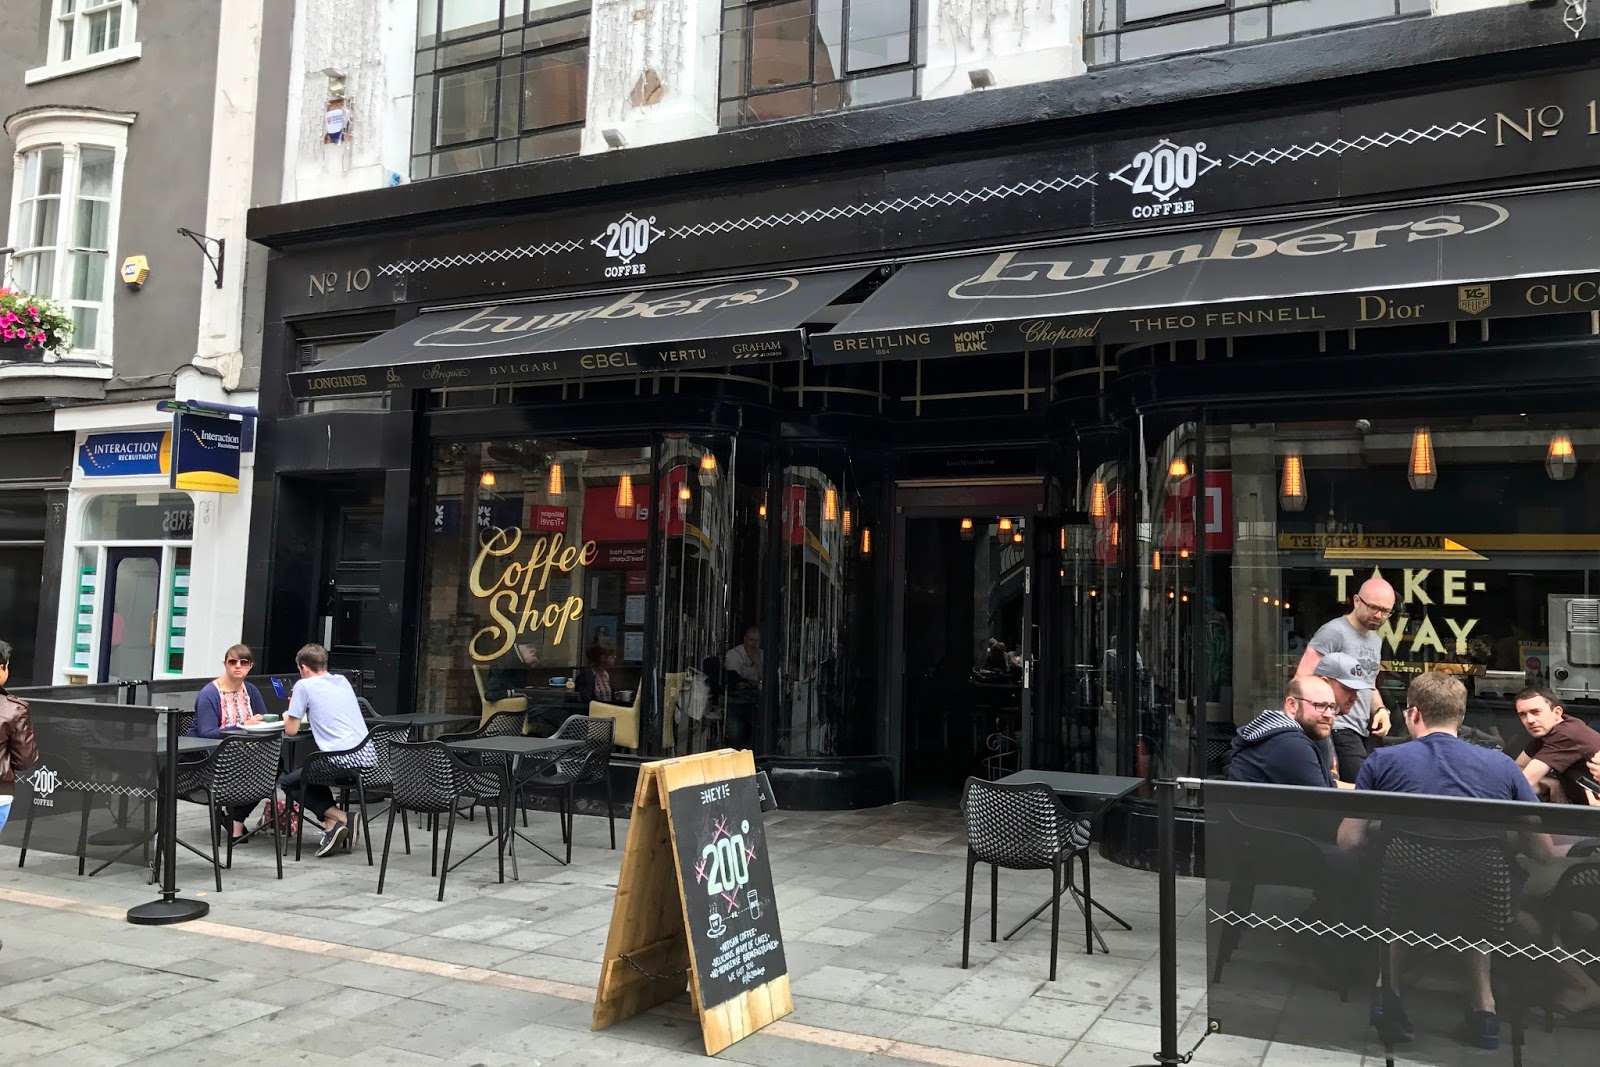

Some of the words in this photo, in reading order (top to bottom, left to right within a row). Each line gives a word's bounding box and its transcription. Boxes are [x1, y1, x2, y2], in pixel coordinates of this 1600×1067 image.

[1131, 200, 1195, 219] COFFEE
[948, 201, 1510, 301] Lumbers
[604, 264, 646, 278] COFFEE
[346, 267, 371, 293] 10
[1464, 287, 1485, 299] TAG
[1525, 281, 1600, 306] GUC
[414, 277, 799, 346] Lumbers
[1358, 296, 1425, 321] Dior
[1462, 300, 1488, 311] HEUER
[1129, 314, 1196, 332] THEO
[1204, 305, 1326, 327] FENNELL
[953, 330, 986, 343] MONT
[1019, 316, 1103, 346] Chopard
[732, 341, 782, 354] GRAHAM
[833, 333, 931, 352] BREITLING
[954, 339, 987, 352] BLANC
[580, 352, 638, 370] EBEL
[659, 348, 707, 363] VERTU
[489, 361, 558, 375] BVLGARI
[307, 374, 367, 390] LONGINES
[201, 429, 239, 443] Interaction
[94, 442, 159, 454] INTERACTION
[118, 453, 157, 461] RECRUITMENT
[469, 526, 599, 598] Coffee
[1329, 564, 1486, 605] TKE-
[468, 590, 584, 662] Shop
[1377, 614, 1481, 655] WAY
[33, 798, 54, 807] COFFEE
[740, 927, 755, 941] COFFEE
